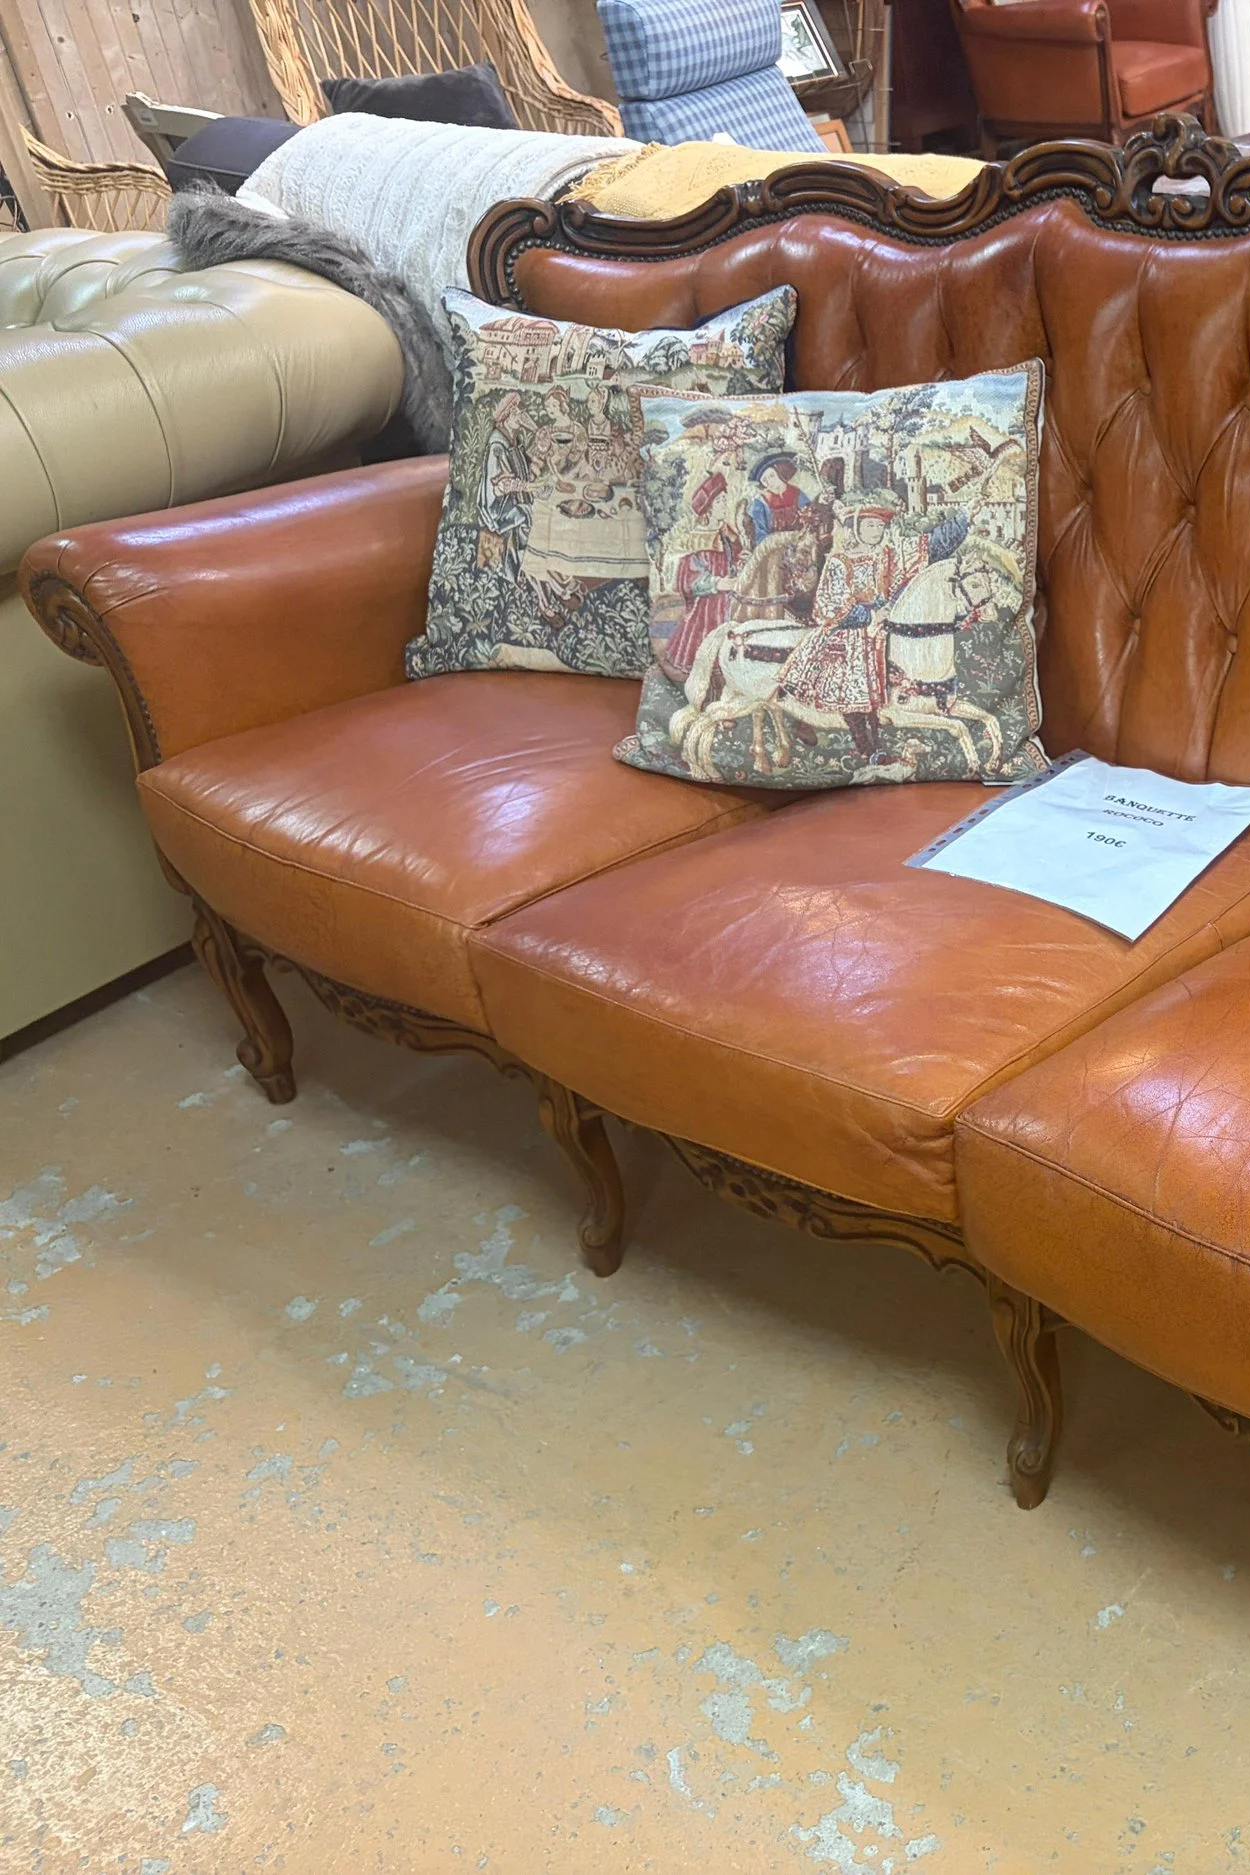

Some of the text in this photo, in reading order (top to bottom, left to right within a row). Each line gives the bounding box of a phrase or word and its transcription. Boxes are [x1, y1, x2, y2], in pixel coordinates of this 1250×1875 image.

[1103, 795, 1196, 822] BANQUETTE
[1102, 809, 1164, 827] ROCOCO
[1086, 831, 1127, 848] 190€
